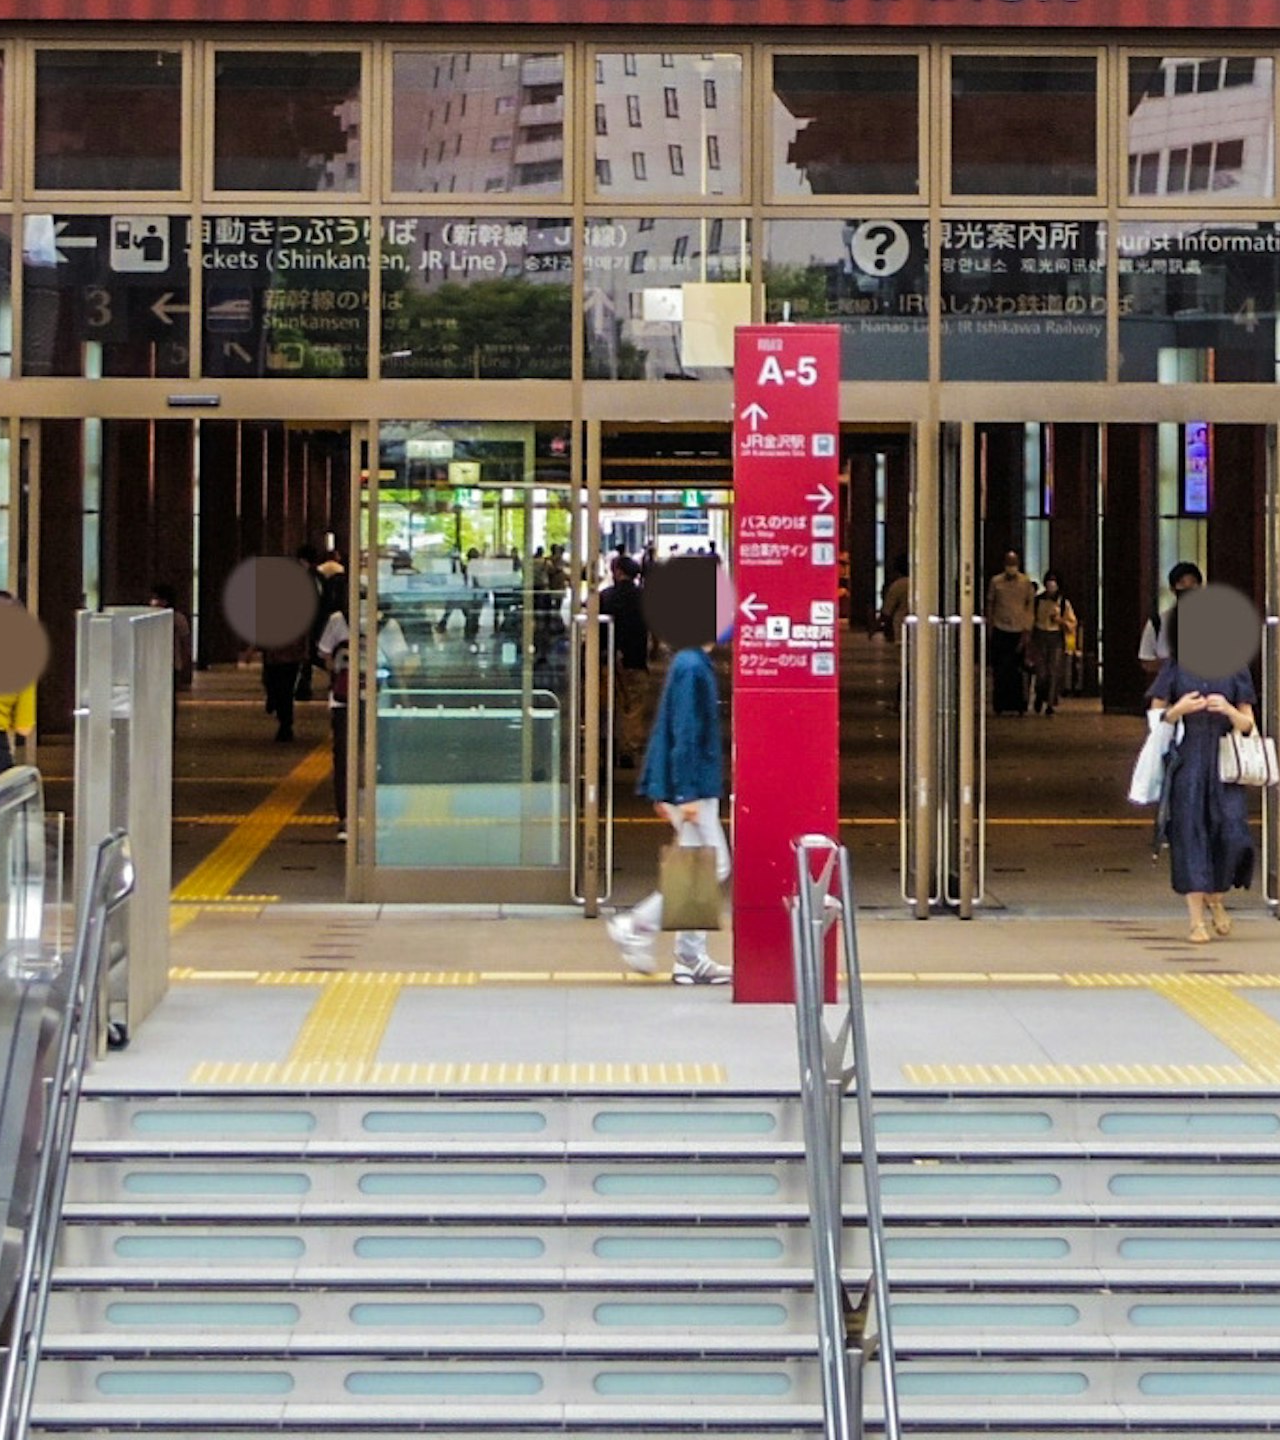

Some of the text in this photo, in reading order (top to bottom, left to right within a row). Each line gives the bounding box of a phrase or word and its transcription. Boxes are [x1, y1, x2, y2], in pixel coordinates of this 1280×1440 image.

[1095, 231, 1171, 252] Turist
[86, 289, 111, 327] 3
[757, 356, 818, 386] A-5
[740, 515, 808, 530] バスのりば
